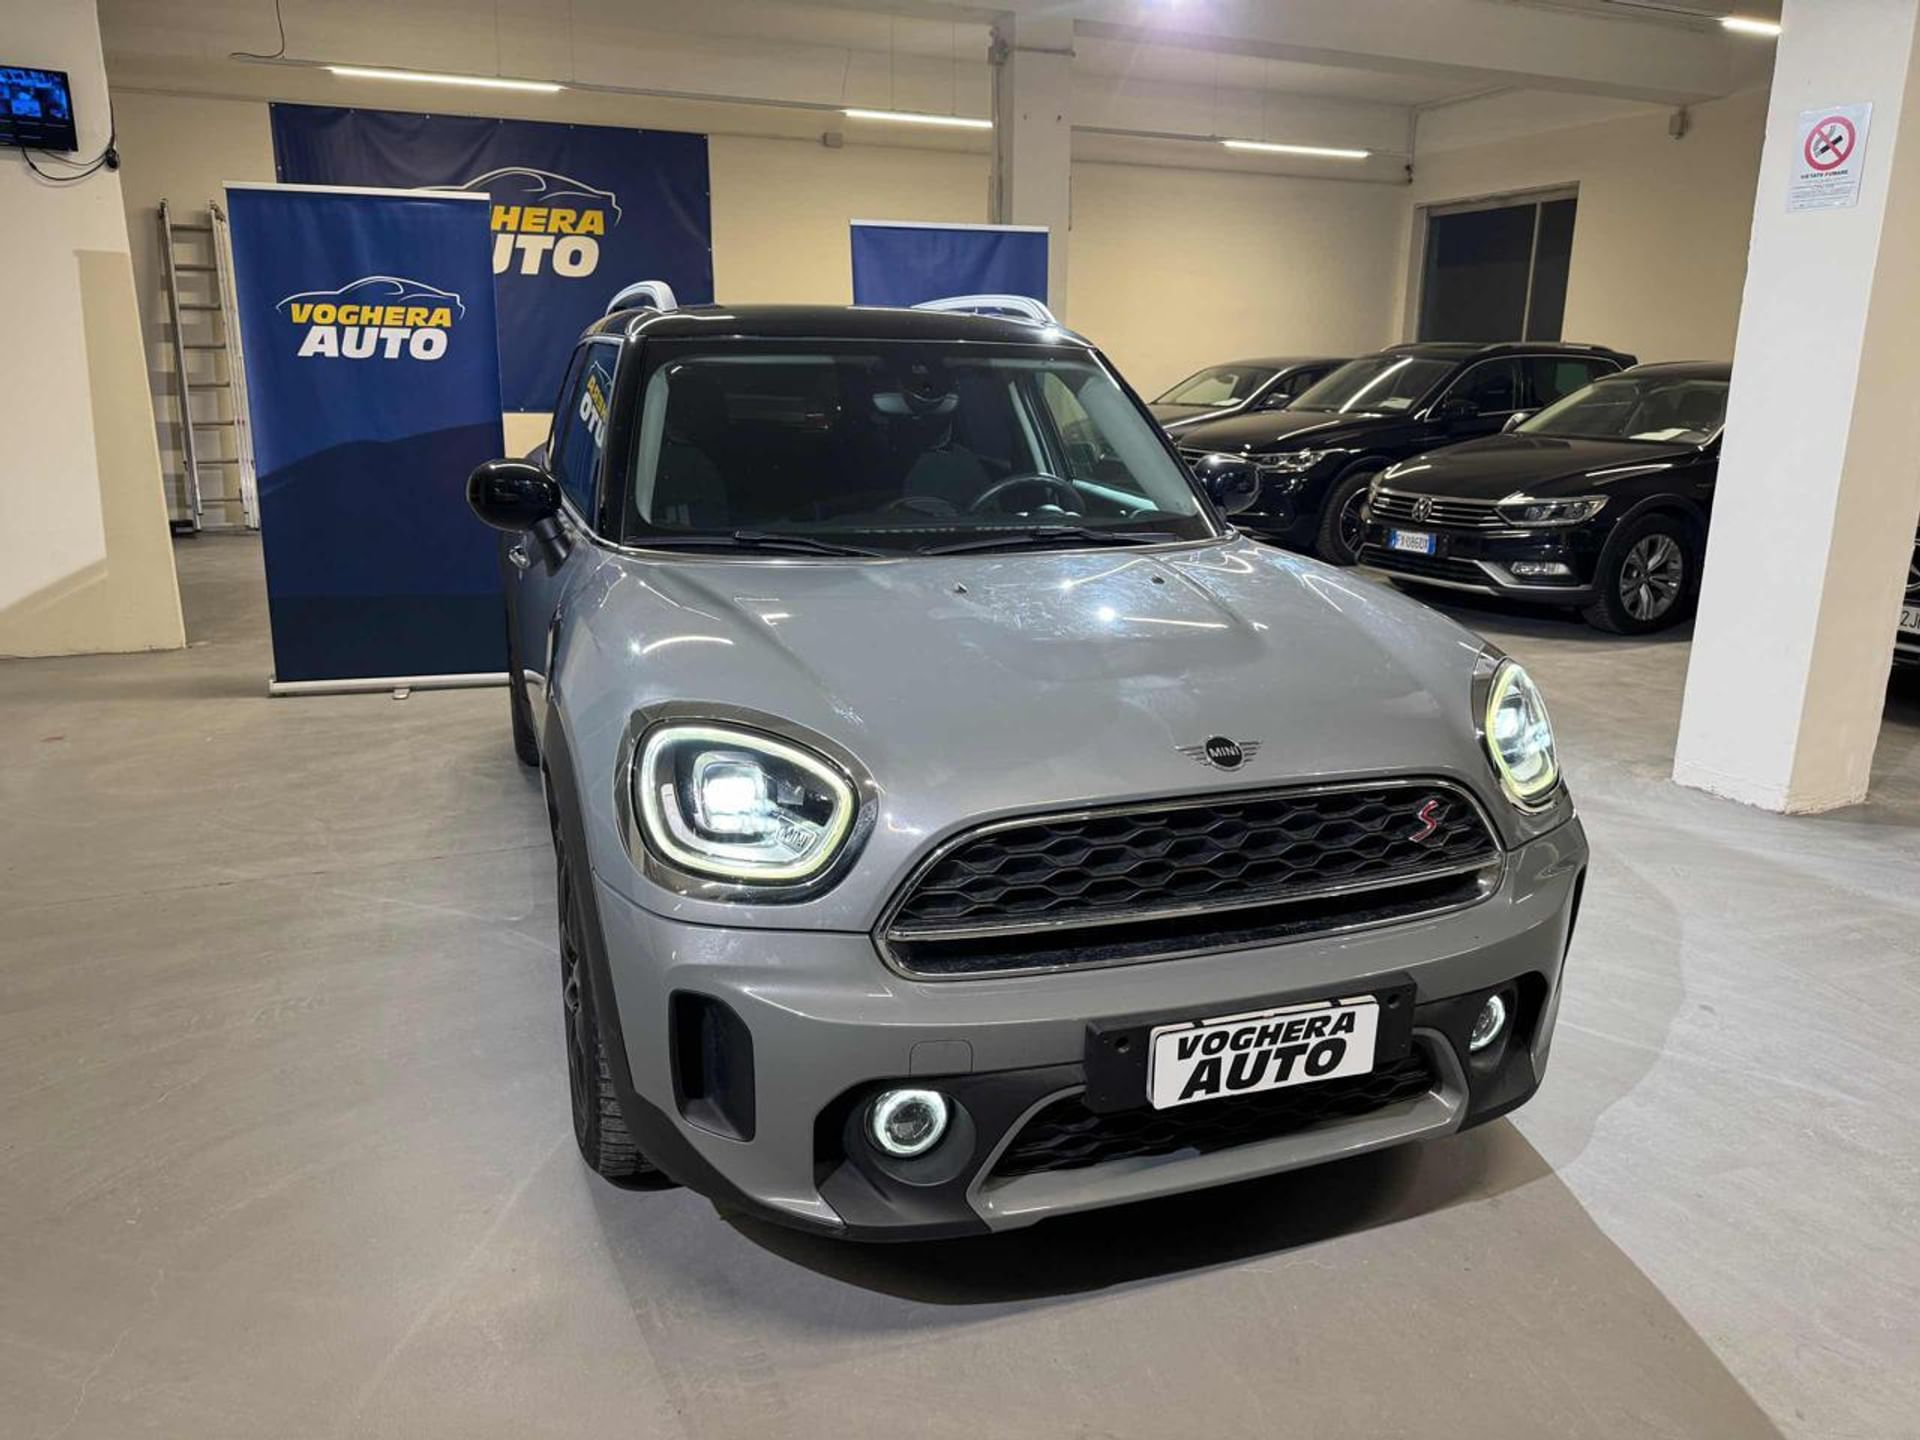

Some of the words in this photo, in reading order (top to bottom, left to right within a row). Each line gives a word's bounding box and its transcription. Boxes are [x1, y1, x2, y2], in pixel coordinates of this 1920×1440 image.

[291, 303, 452, 328] VOGHERA
[297, 325, 448, 361] AUTO
[1900, 610, 1920, 630] 2J
[1208, 745, 1241, 758] MINI
[1408, 800, 1439, 843] S
[1177, 1011, 1356, 1061] VOGHERA
[1177, 1037, 1347, 1101] AUTO
